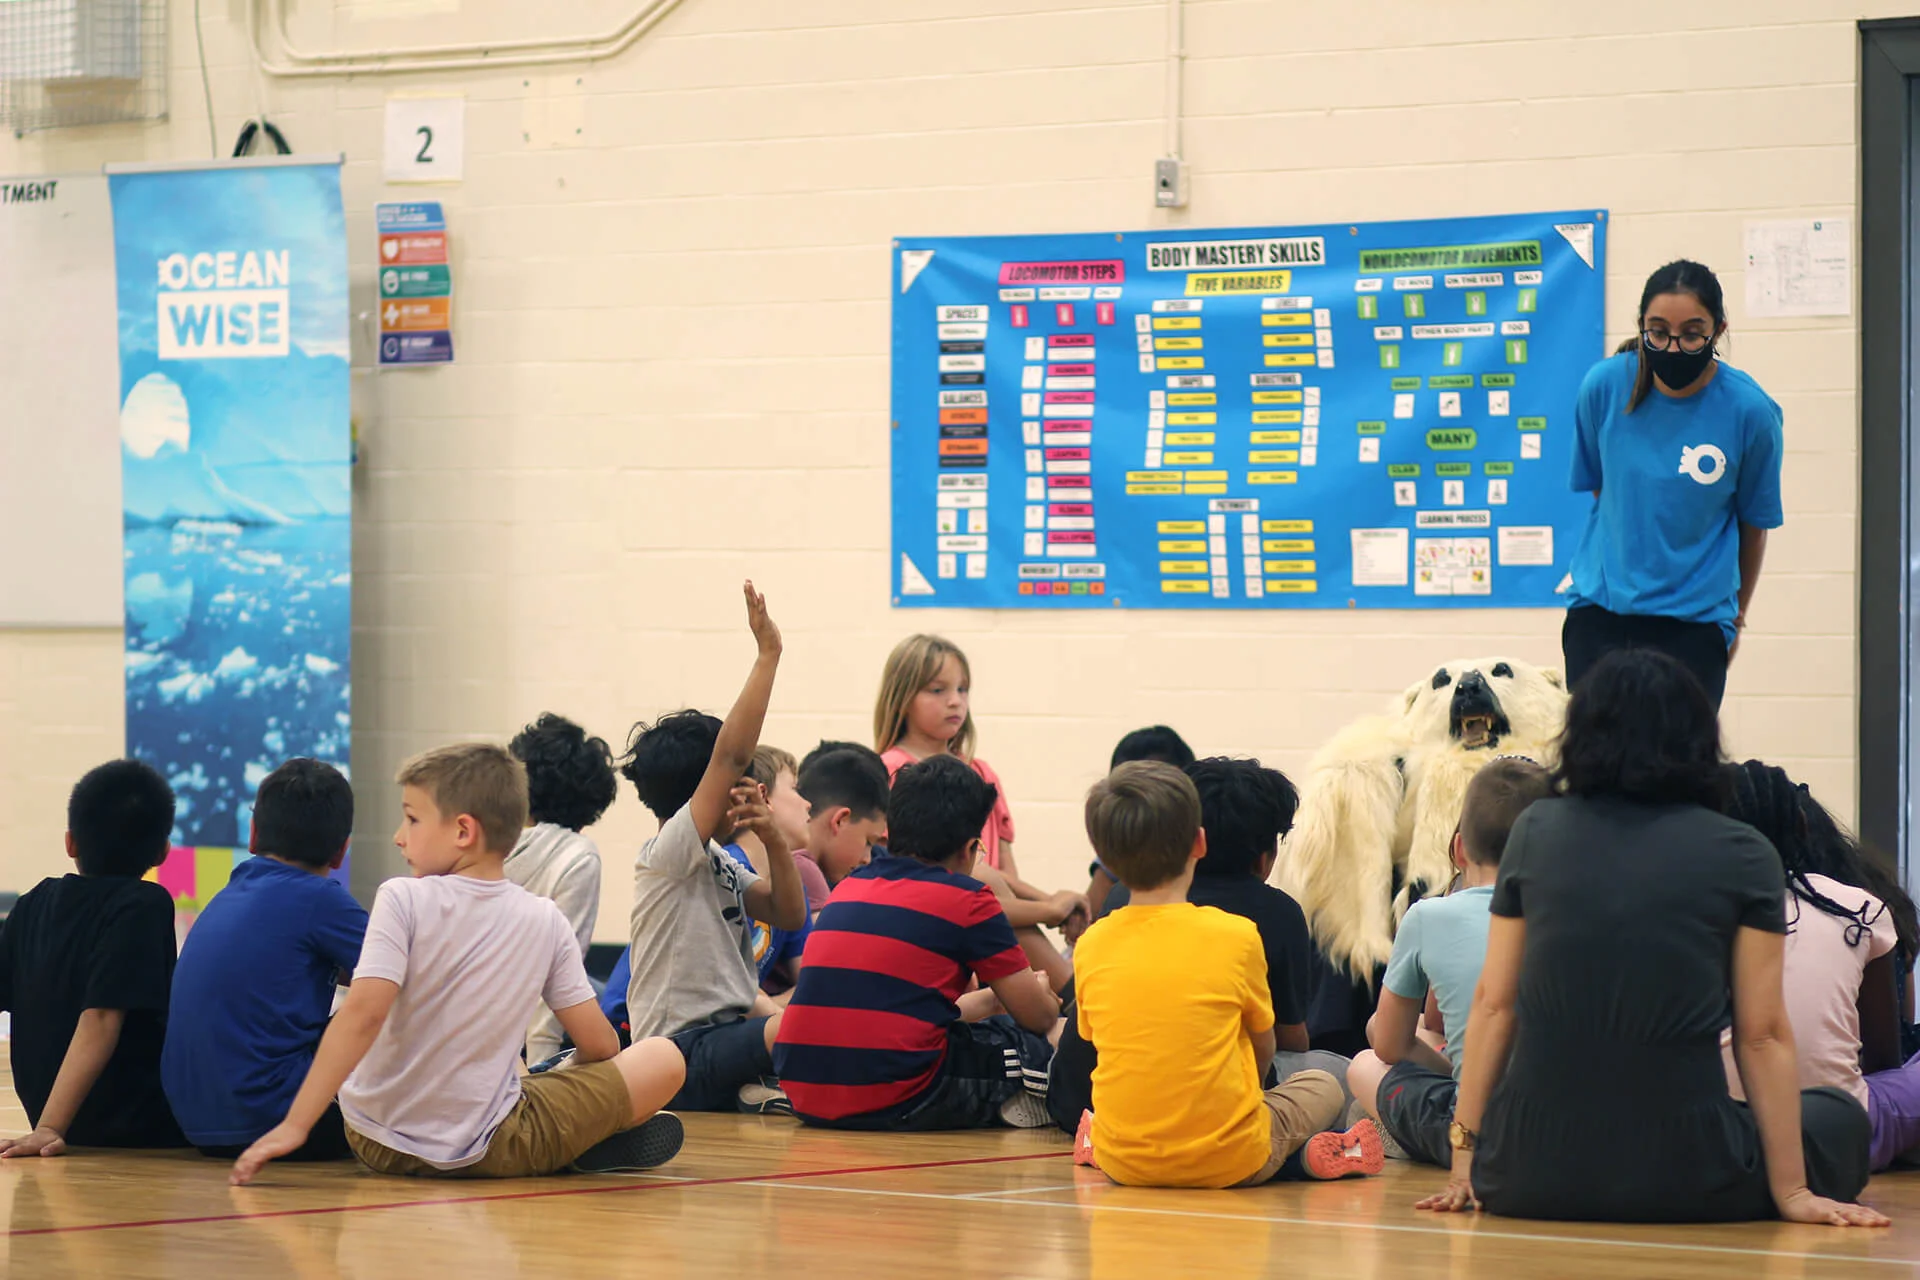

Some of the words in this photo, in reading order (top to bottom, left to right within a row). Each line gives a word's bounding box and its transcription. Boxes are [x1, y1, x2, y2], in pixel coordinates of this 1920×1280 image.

[415, 125, 434, 163] 2
[1150, 247, 1190, 268] BODY
[1196, 244, 1265, 266] MASTERY
[1269, 241, 1321, 264] SKILLS
[1462, 244, 1538, 264] MOVEMENTS
[158, 249, 289, 289] OCEAN
[1008, 265, 1080, 281] LOCOMOTOR
[1081, 263, 1116, 281] STEPS
[1195, 278, 1218, 292] FIVE
[1222, 274, 1283, 291] VARIABLES
[1462, 276, 1478, 284] THE
[1480, 274, 1501, 283] FEET
[168, 302, 280, 347] WISE
[1430, 433, 1472, 446] MANY
[1419, 515, 1455, 524] LEARNING
[1456, 513, 1487, 523] PROCESS
